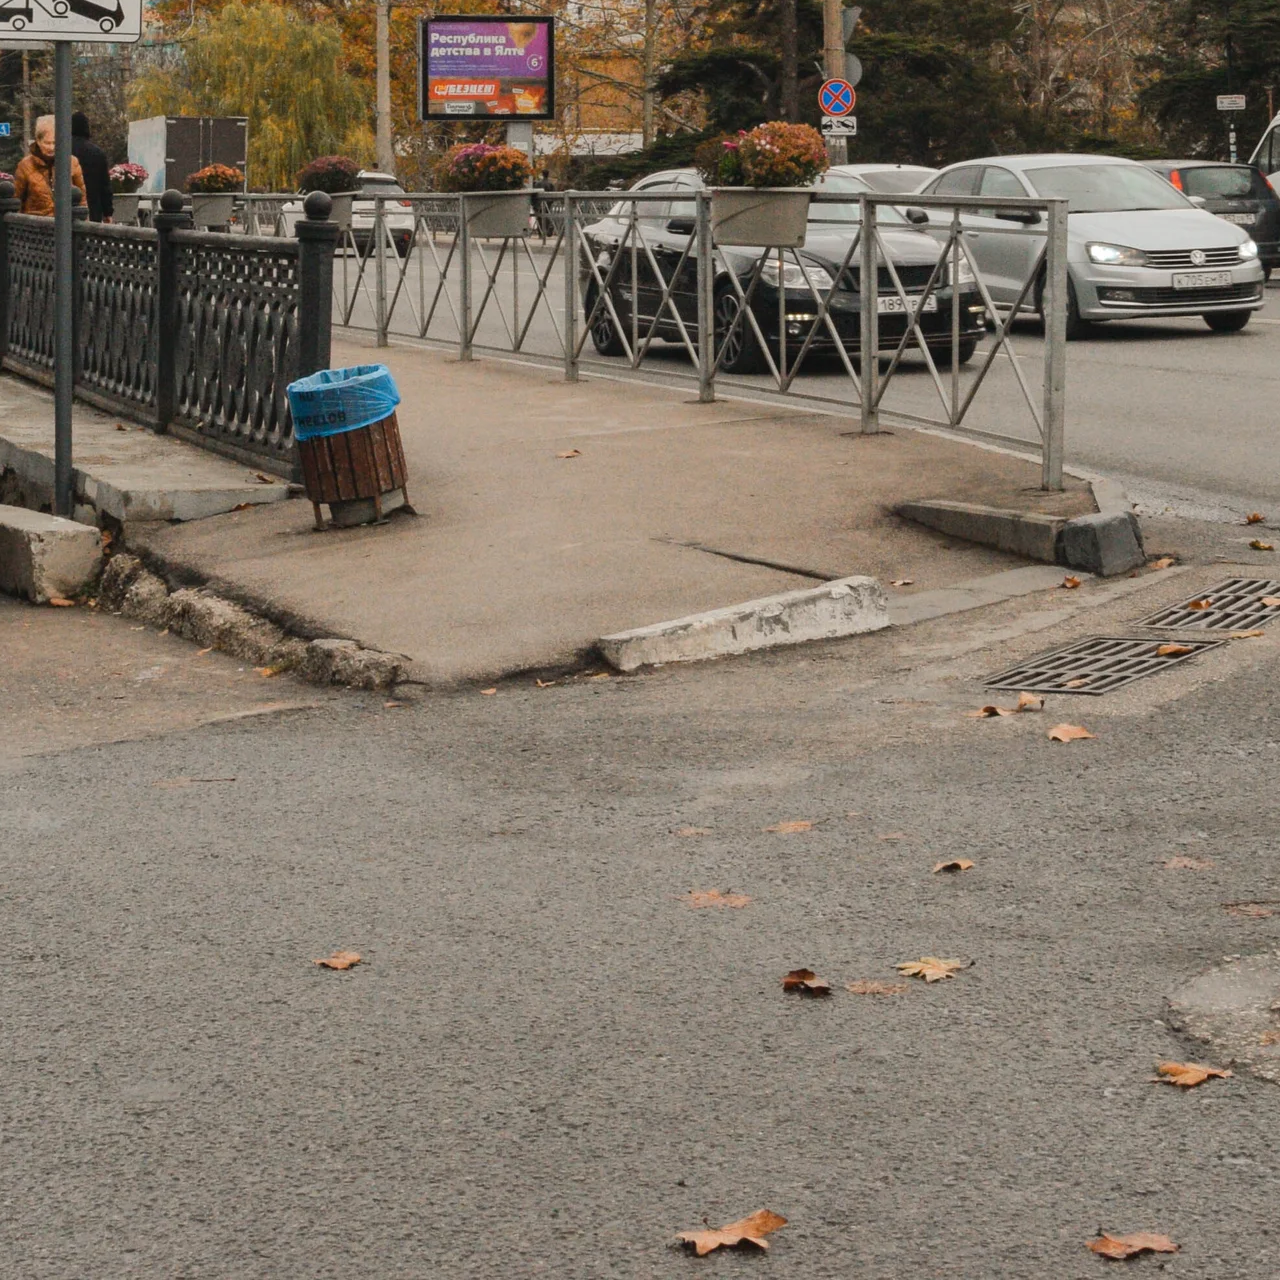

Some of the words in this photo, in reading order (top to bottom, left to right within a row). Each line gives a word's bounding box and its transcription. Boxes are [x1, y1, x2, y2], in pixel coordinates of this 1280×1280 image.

[430, 32, 506, 46] Республика
[430, 46, 480, 58] детства
[483, 47, 492, 56] в
[494, 45, 525, 56] Ялте
